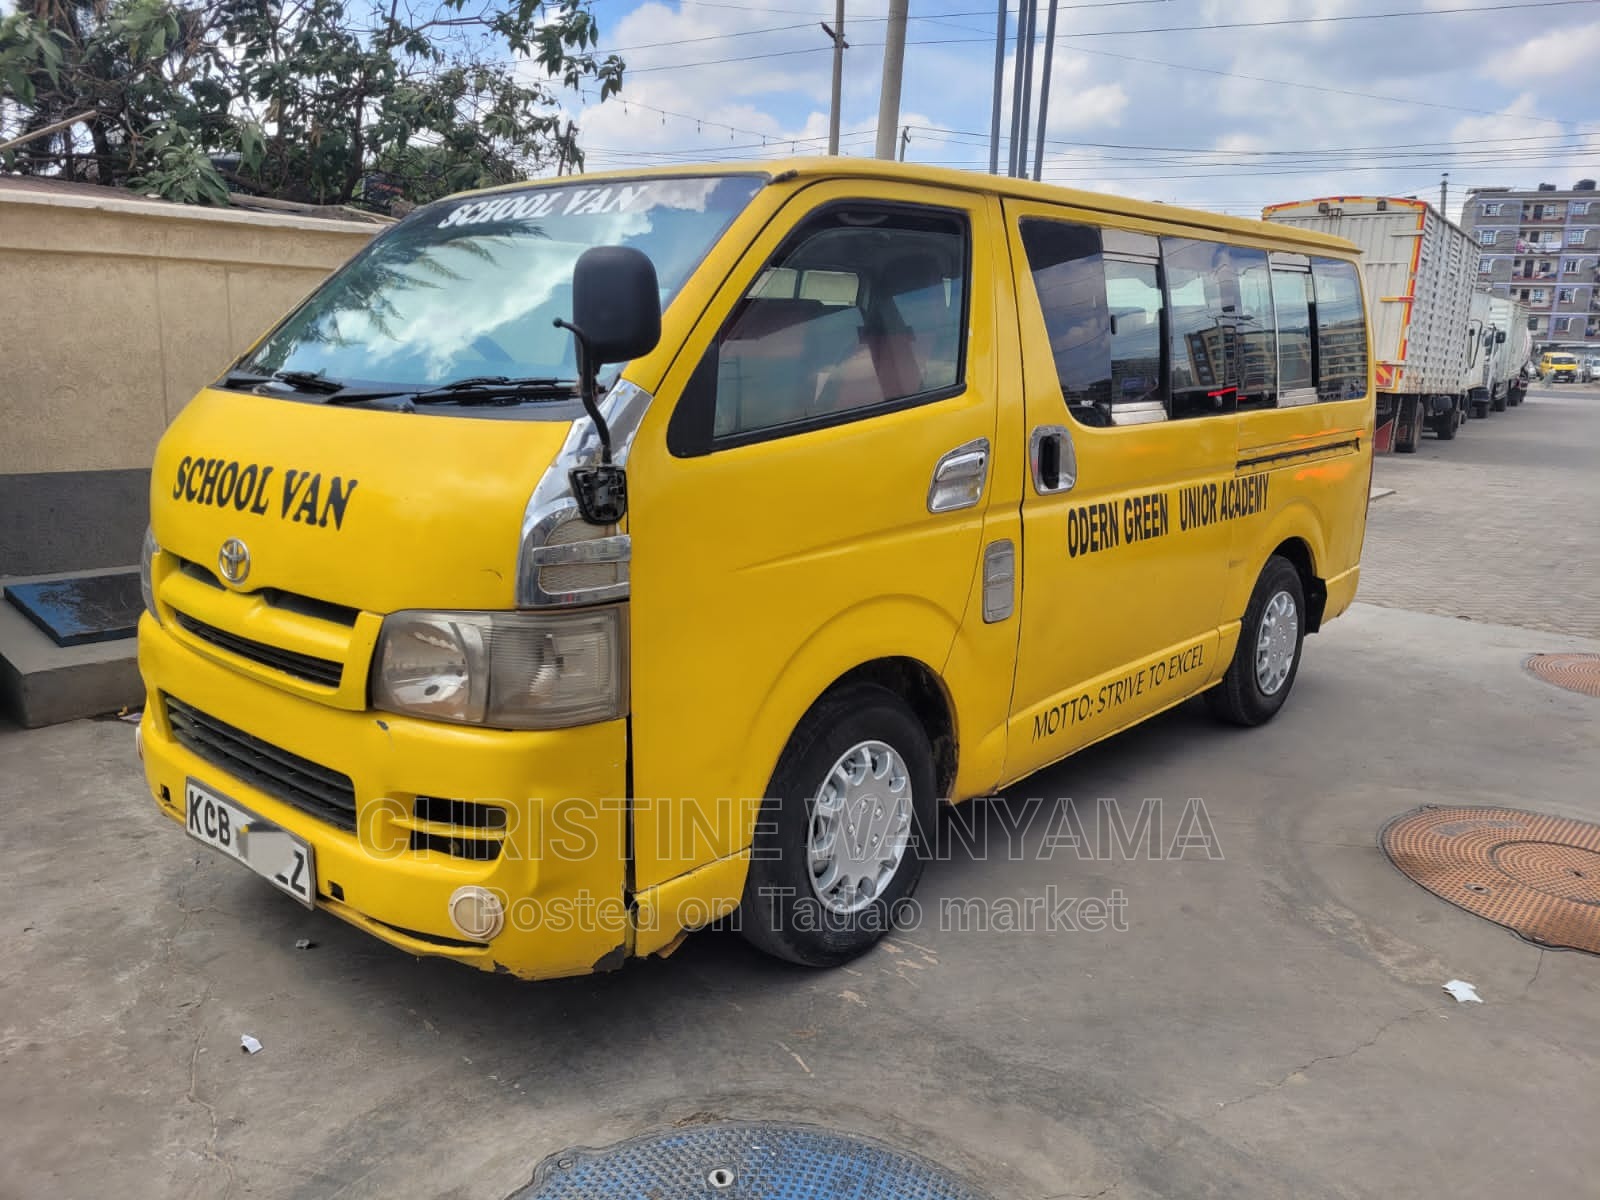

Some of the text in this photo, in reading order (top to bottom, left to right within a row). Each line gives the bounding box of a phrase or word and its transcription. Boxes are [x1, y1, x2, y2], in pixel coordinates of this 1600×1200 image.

[437, 186, 649, 229] SCHOOL VAN
[173, 456, 359, 531] SCHOOL VAN
[1067, 473, 1270, 558] ODERN GREEN UNIOR ACADEMY
[1032, 644, 1204, 744] MOTTO: STRIVE TO EXCEL
[189, 789, 231, 846] KCB
